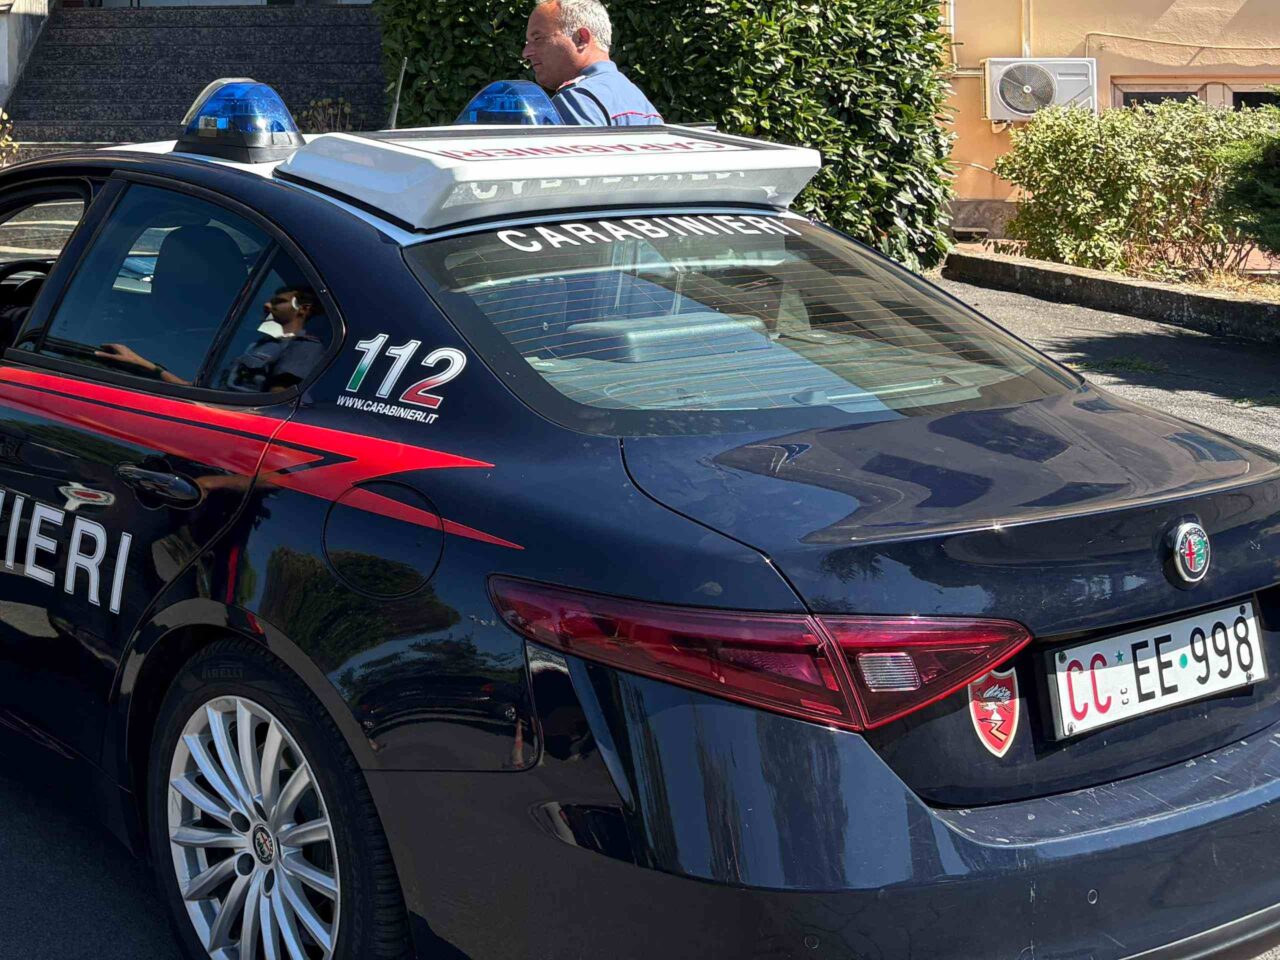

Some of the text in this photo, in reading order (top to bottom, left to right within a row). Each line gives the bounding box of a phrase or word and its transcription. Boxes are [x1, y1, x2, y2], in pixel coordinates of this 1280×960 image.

[496, 215, 802, 253] CARABINIERI
[345, 333, 467, 410] 112
[336, 394, 439, 425] WWW.CARABINIERI.IT
[1066, 615, 1255, 722] CC EE 998
